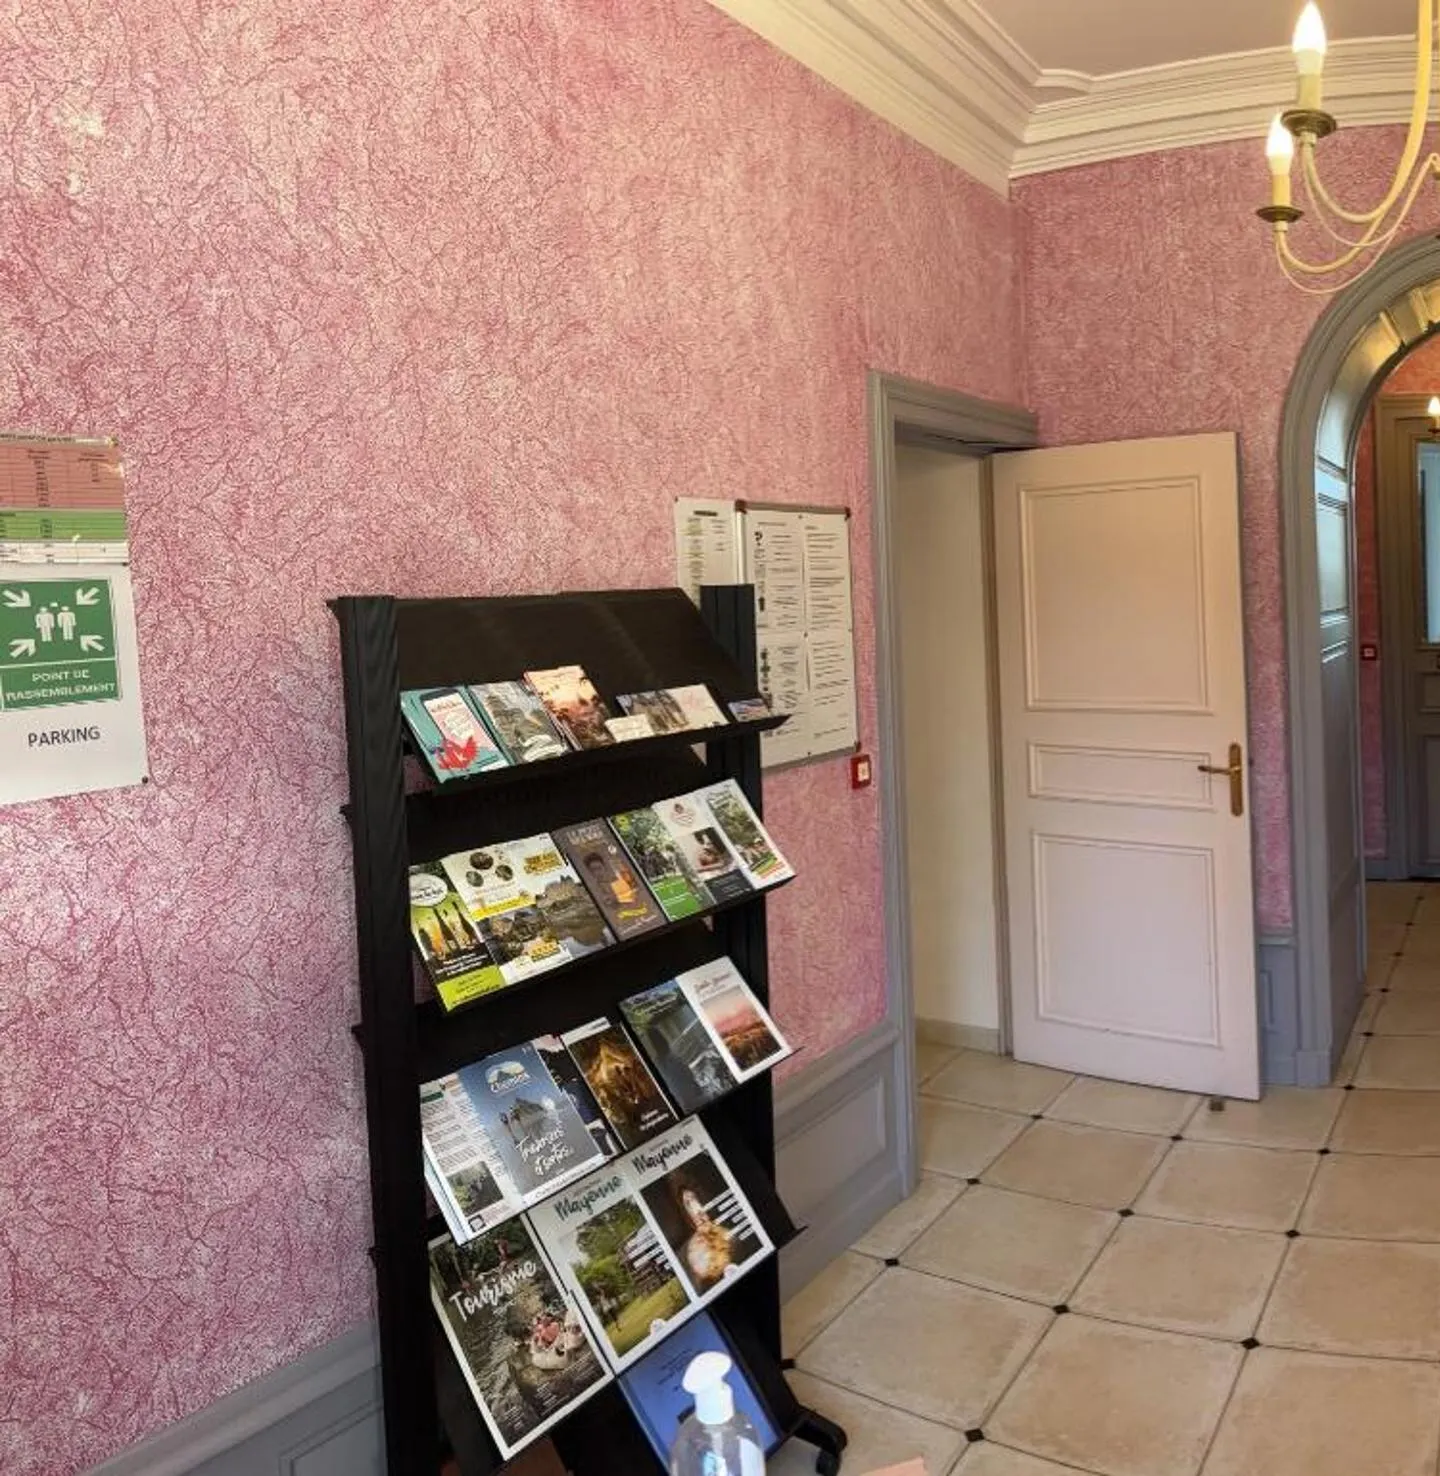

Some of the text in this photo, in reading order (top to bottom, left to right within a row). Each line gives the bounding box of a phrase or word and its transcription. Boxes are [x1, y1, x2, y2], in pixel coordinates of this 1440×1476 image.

[31, 669, 91, 682] POINT DE
[27, 725, 101, 748] PARKING
[634, 1133, 693, 1175] Mayenne
[553, 1175, 622, 1221] Mayenne
[448, 1260, 536, 1322] Tourisme
